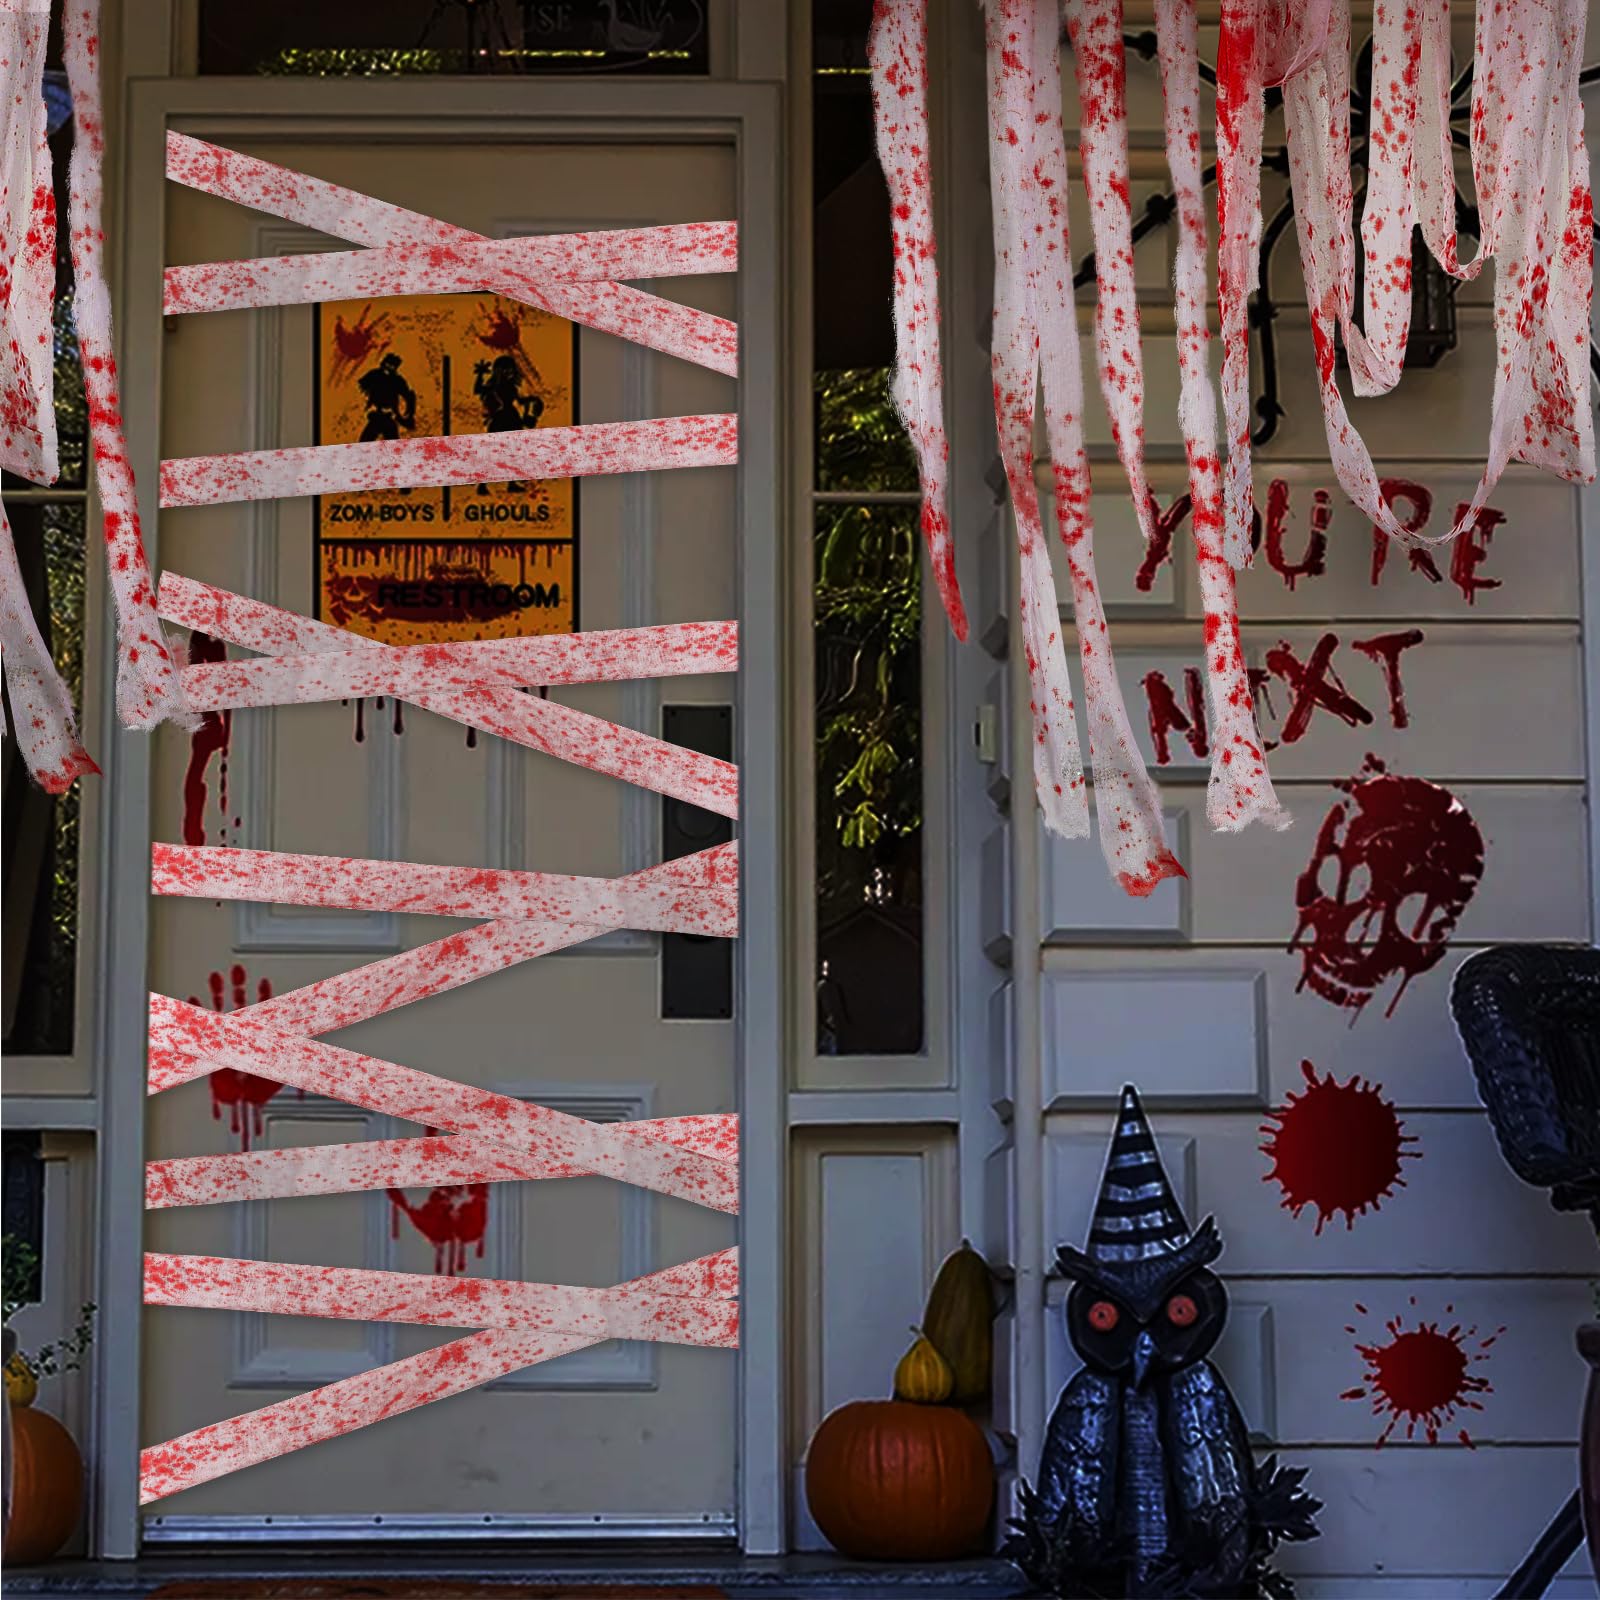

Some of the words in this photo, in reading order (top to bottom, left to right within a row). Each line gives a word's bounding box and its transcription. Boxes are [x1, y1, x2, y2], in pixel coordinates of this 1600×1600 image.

[329, 504, 435, 522] ZOM-BOYS
[464, 504, 550, 522] GHOULS
[378, 583, 560, 608] RESTROOM
[1139, 628, 1424, 764] NXT
